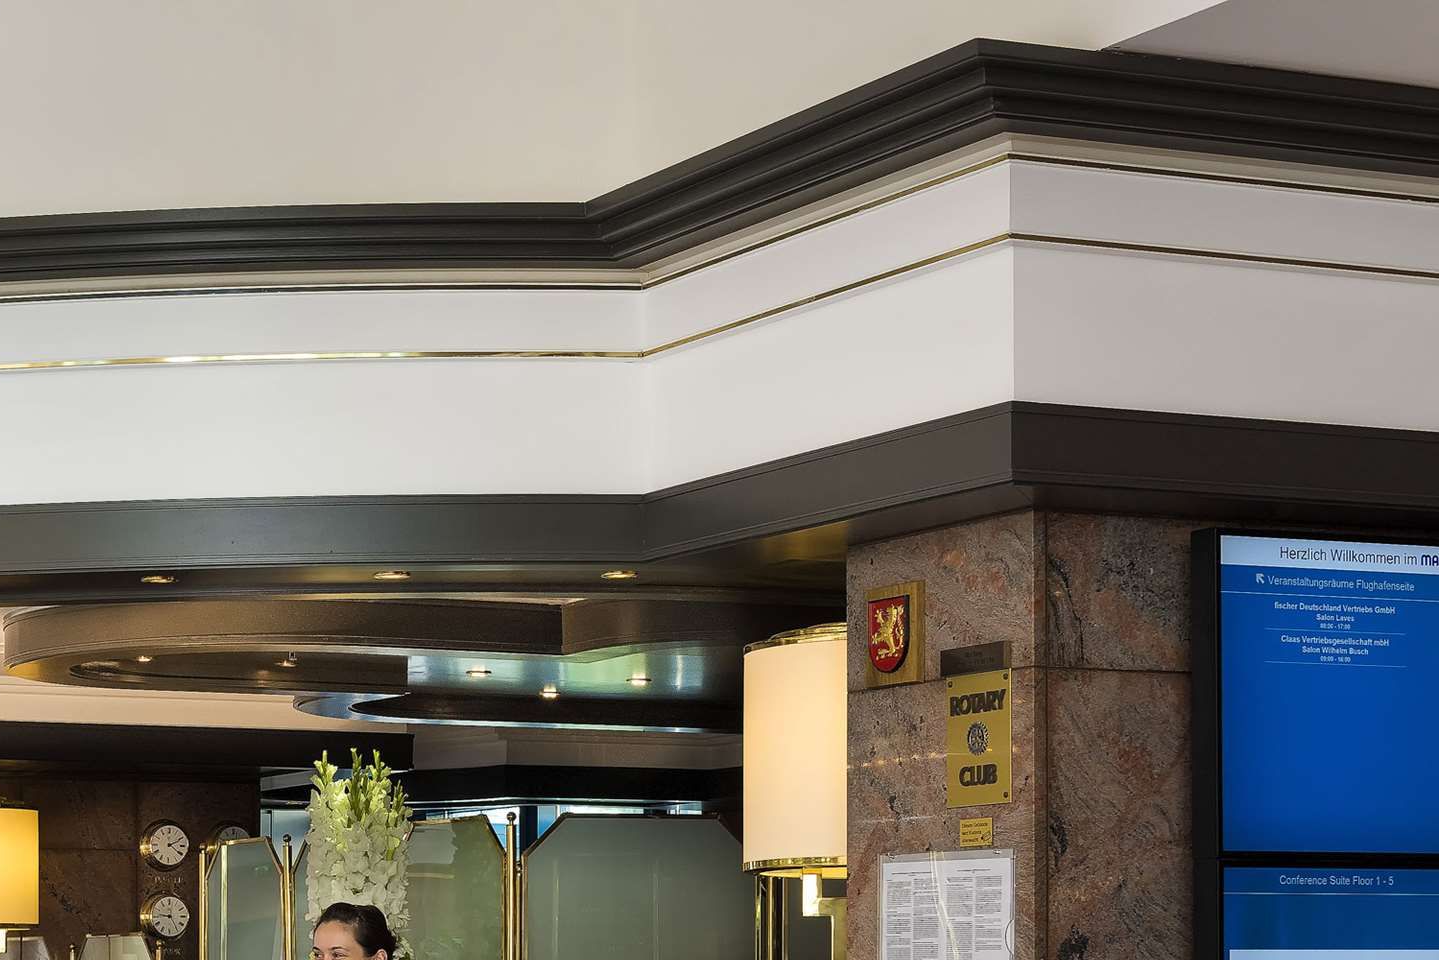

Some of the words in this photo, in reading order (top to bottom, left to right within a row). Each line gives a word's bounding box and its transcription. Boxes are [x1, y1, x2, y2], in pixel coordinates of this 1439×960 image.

[1280, 546, 1327, 561] Herzlich
[1330, 548, 1401, 565] Willkommen
[1404, 552, 1418, 565] im
[1267, 575, 1354, 591] Veranstaltungsräume
[1356, 579, 1415, 592] Flughafenseite
[1299, 602, 1342, 612] Deutschland
[1343, 604, 1373, 613] Vertriebs
[1374, 606, 1396, 614] GmbH
[1316, 613, 1335, 621] Salon
[1301, 635, 1373, 647] Vertriebsgesellschaft
[1302, 646, 1321, 654] Salon
[1321, 646, 1348, 655] Wilhelm
[1348, 647, 1369, 655] Busch
[949, 688, 1007, 717] ROTARY
[959, 763, 998, 787] CLUB
[1279, 874, 1328, 886] Conference
[1329, 875, 1351, 886] Suite
[1352, 875, 1374, 886] Floor
[1376, 876, 1381, 886] 1
[1388, 876, 1395, 886] 5
